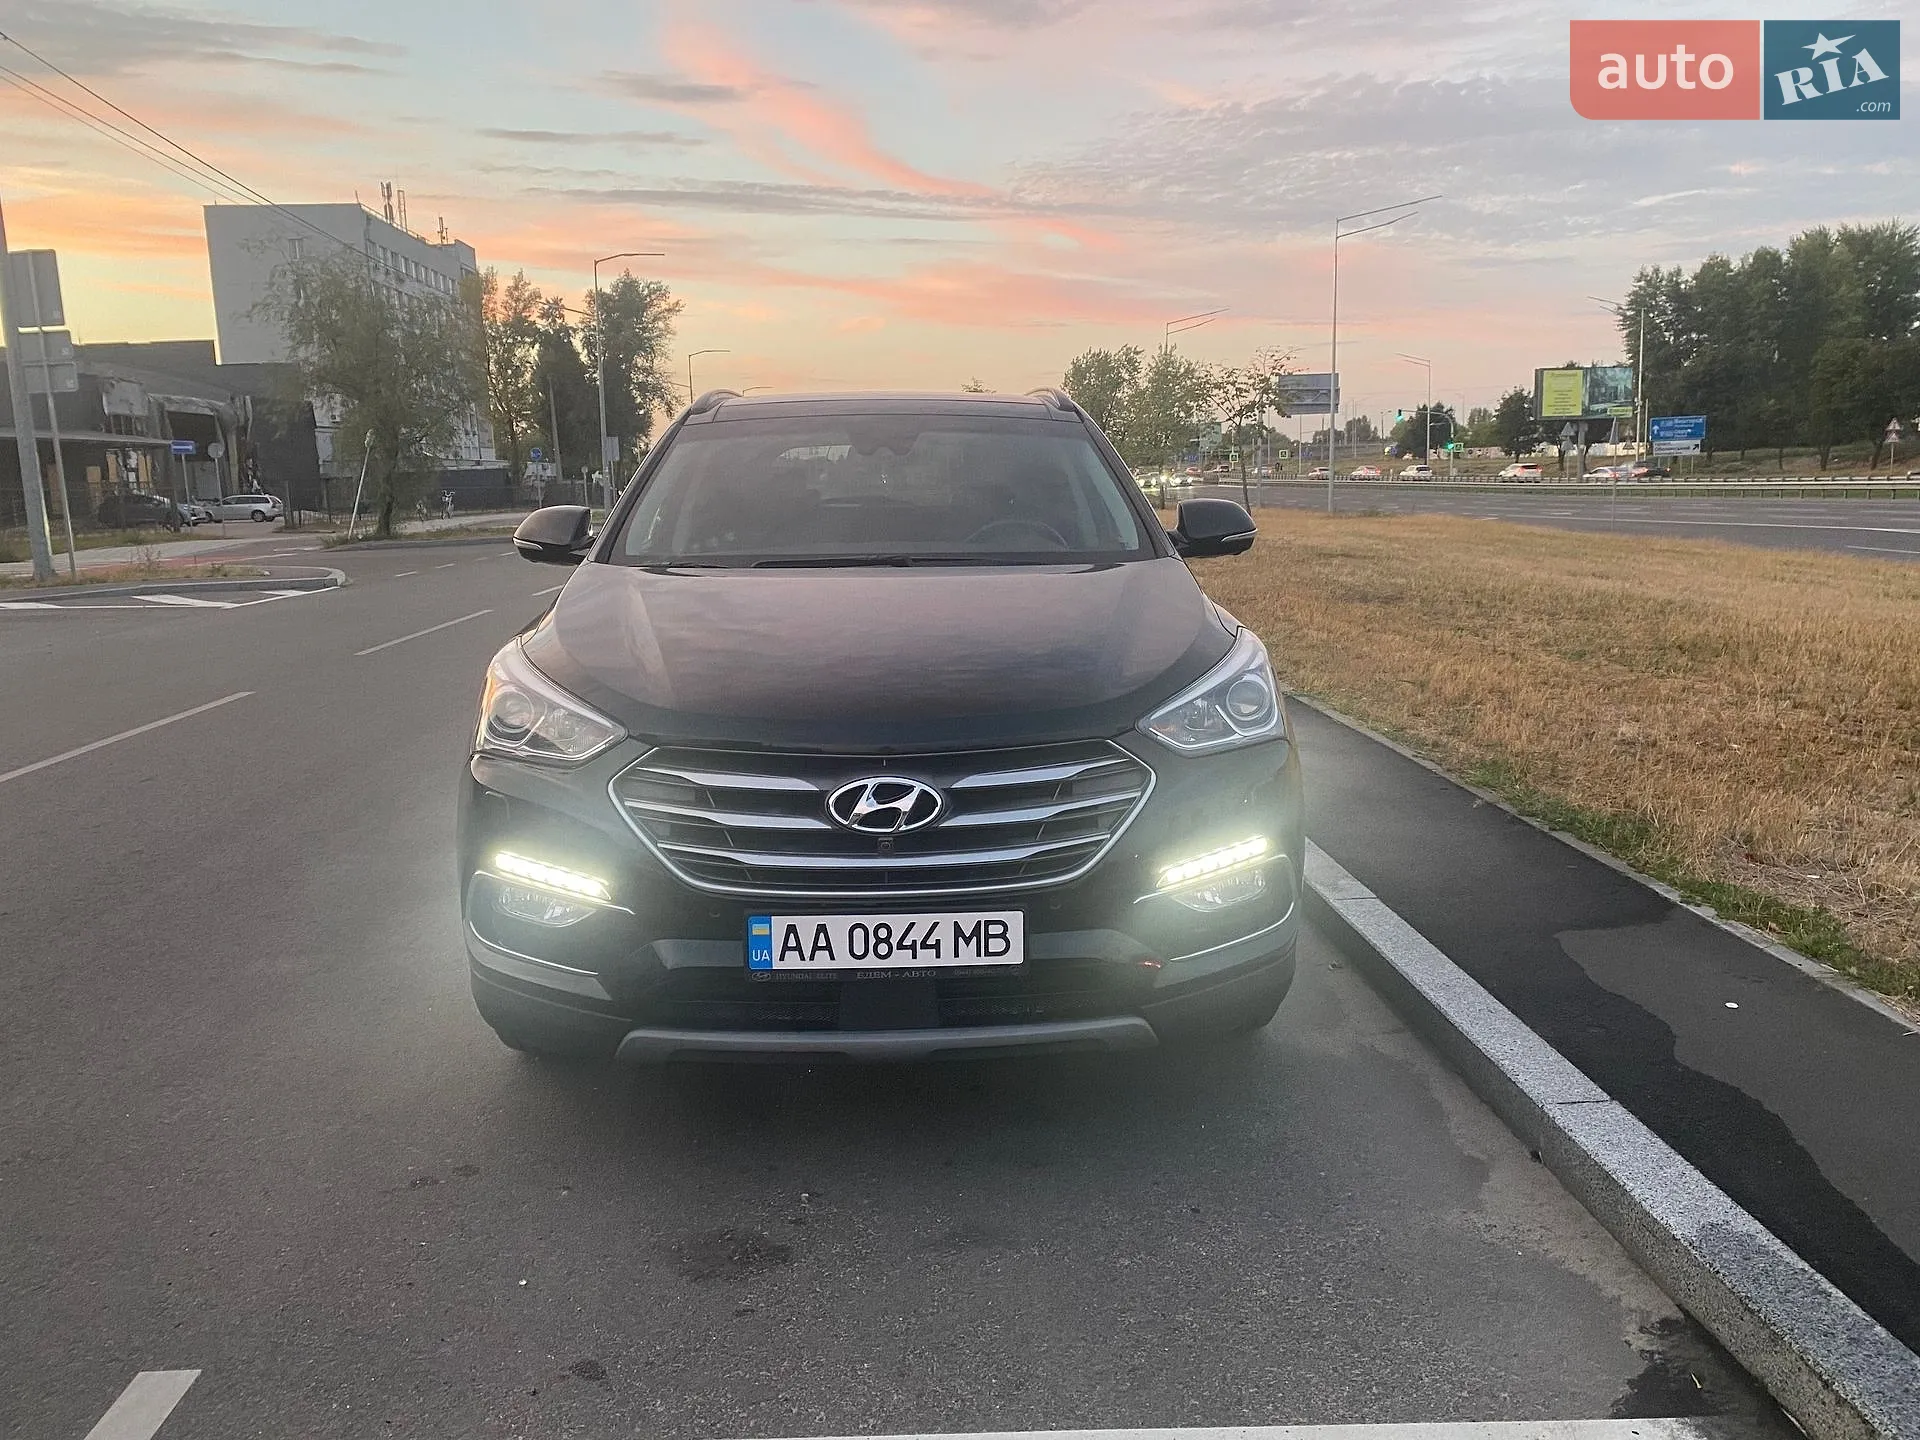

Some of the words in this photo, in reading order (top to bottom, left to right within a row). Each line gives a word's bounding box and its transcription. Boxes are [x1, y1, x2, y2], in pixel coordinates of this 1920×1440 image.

[778, 923, 836, 962] AA
[848, 921, 941, 961] 0844
[953, 919, 1011, 959] MB
[752, 949, 770, 961] UA
[775, 972, 812, 980] HYUNDAI
